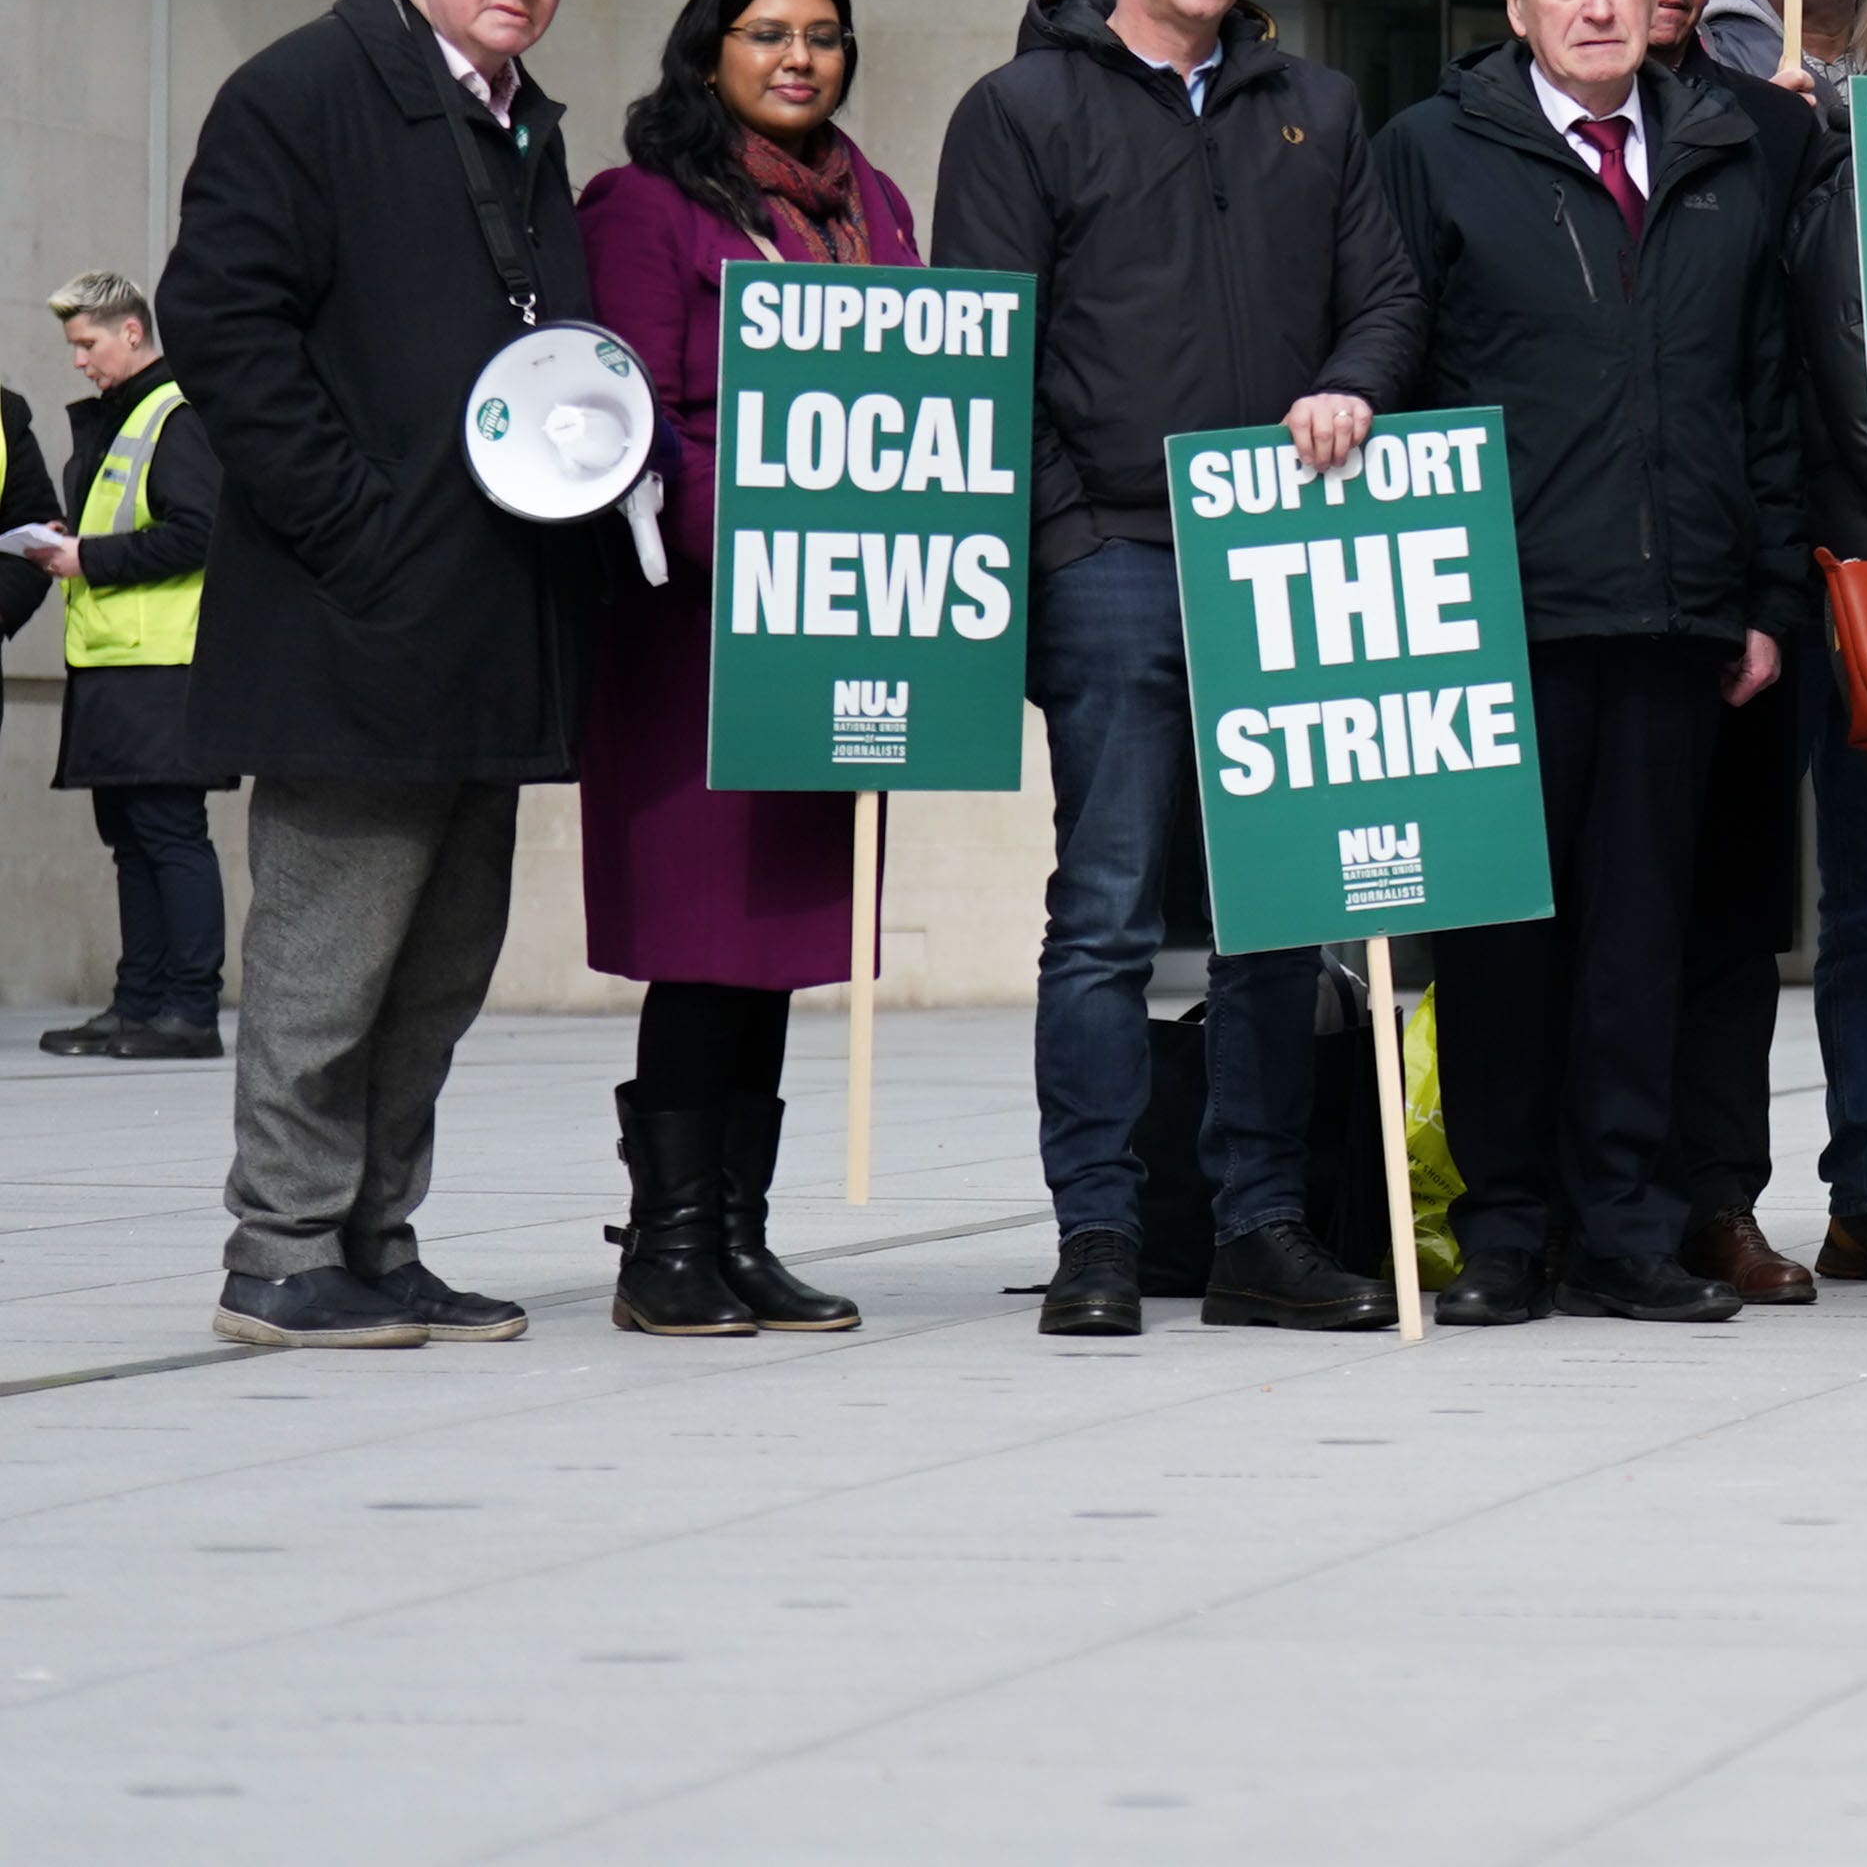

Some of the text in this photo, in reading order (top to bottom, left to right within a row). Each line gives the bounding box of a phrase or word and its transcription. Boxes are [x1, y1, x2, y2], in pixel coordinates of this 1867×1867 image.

[741, 283, 1018, 356] SUPPORT
[737, 392, 1013, 493] LOCAL
[733, 531, 1010, 639] NEWS
[1228, 527, 1480, 672] THE
[835, 681, 907, 716] NUJ
[1217, 683, 1520, 795] STRIKE
[1338, 822, 1420, 864] NUJ
